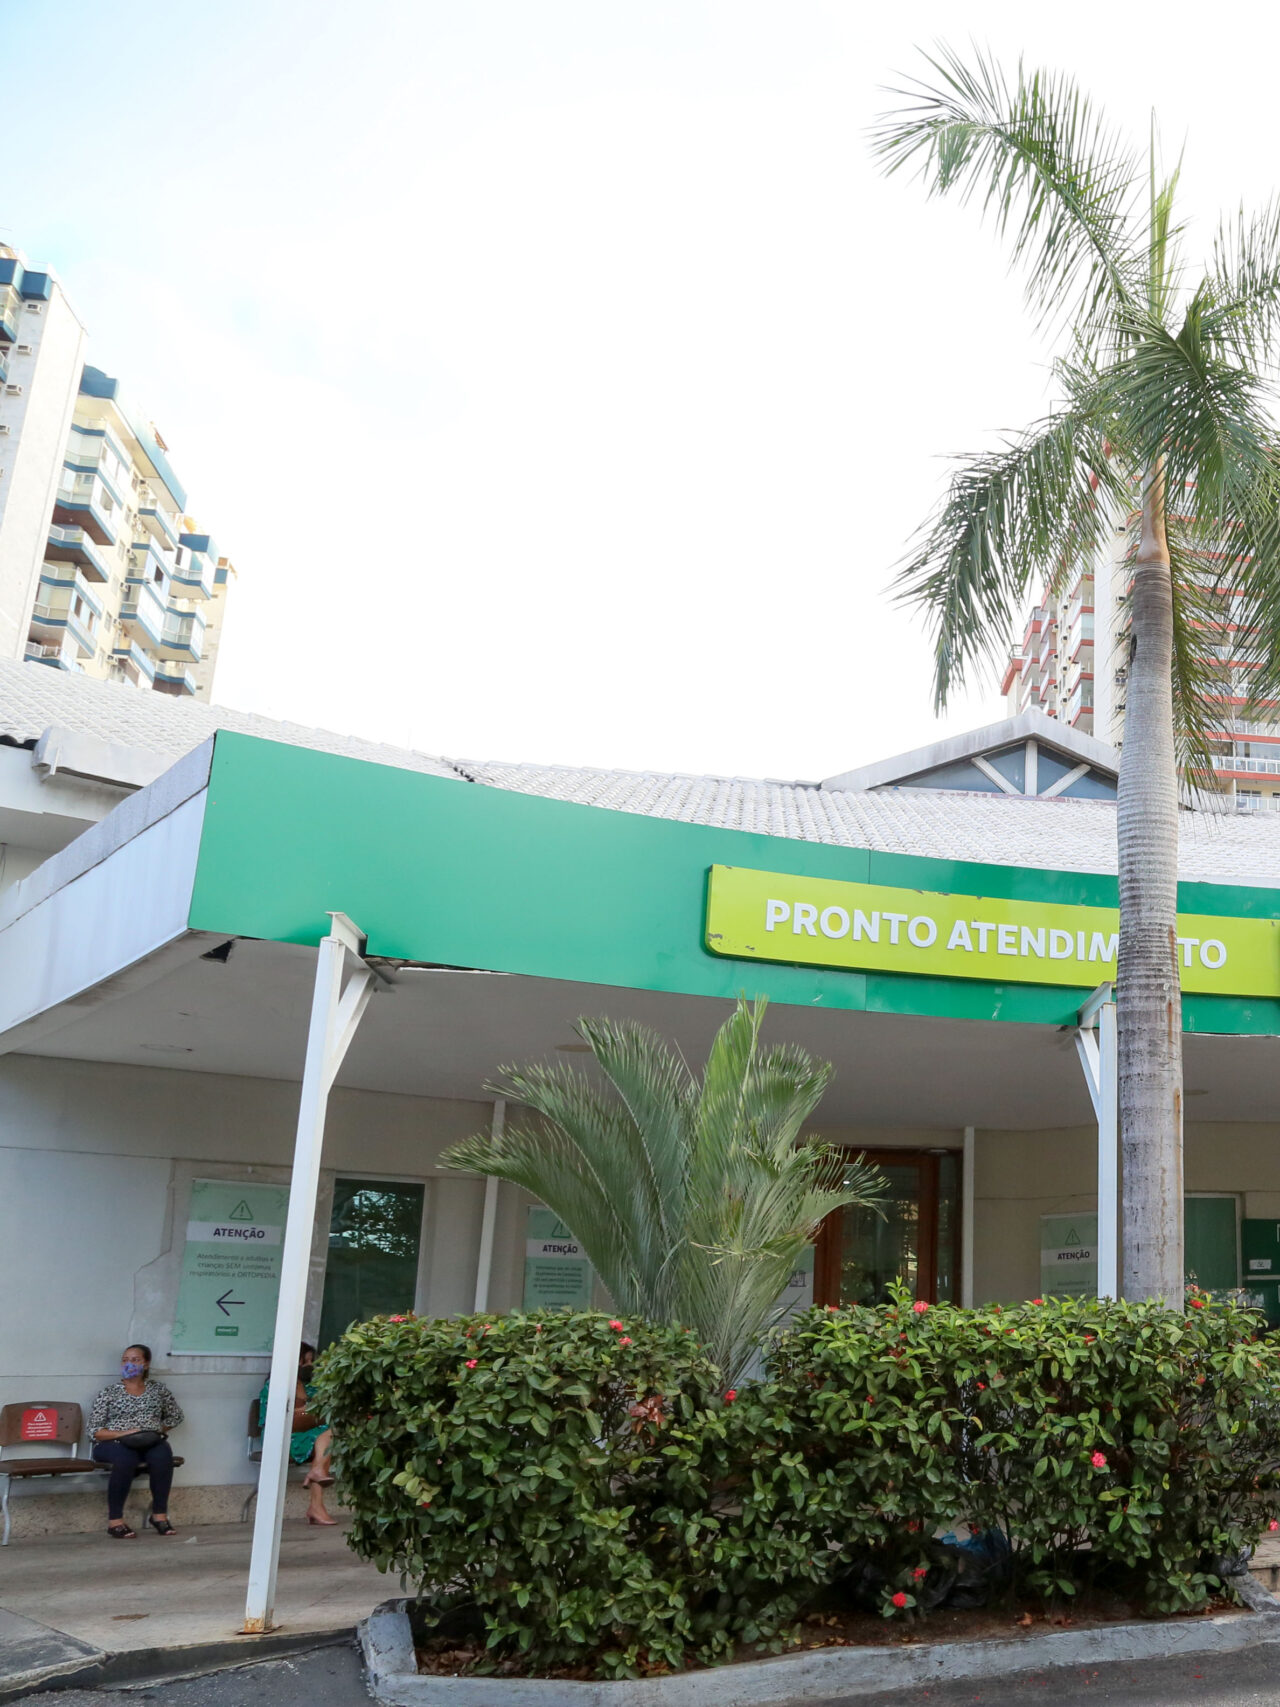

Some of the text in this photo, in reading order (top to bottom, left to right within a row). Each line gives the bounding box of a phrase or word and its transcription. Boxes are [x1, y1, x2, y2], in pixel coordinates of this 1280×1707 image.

[765, 899, 1227, 969] PRONTO ATENDIMTO
[213, 1227, 265, 1240] ATENÇÃO
[542, 1244, 578, 1255] ATENÇÃO
[1057, 1250, 1090, 1261] ATENÇÃO
